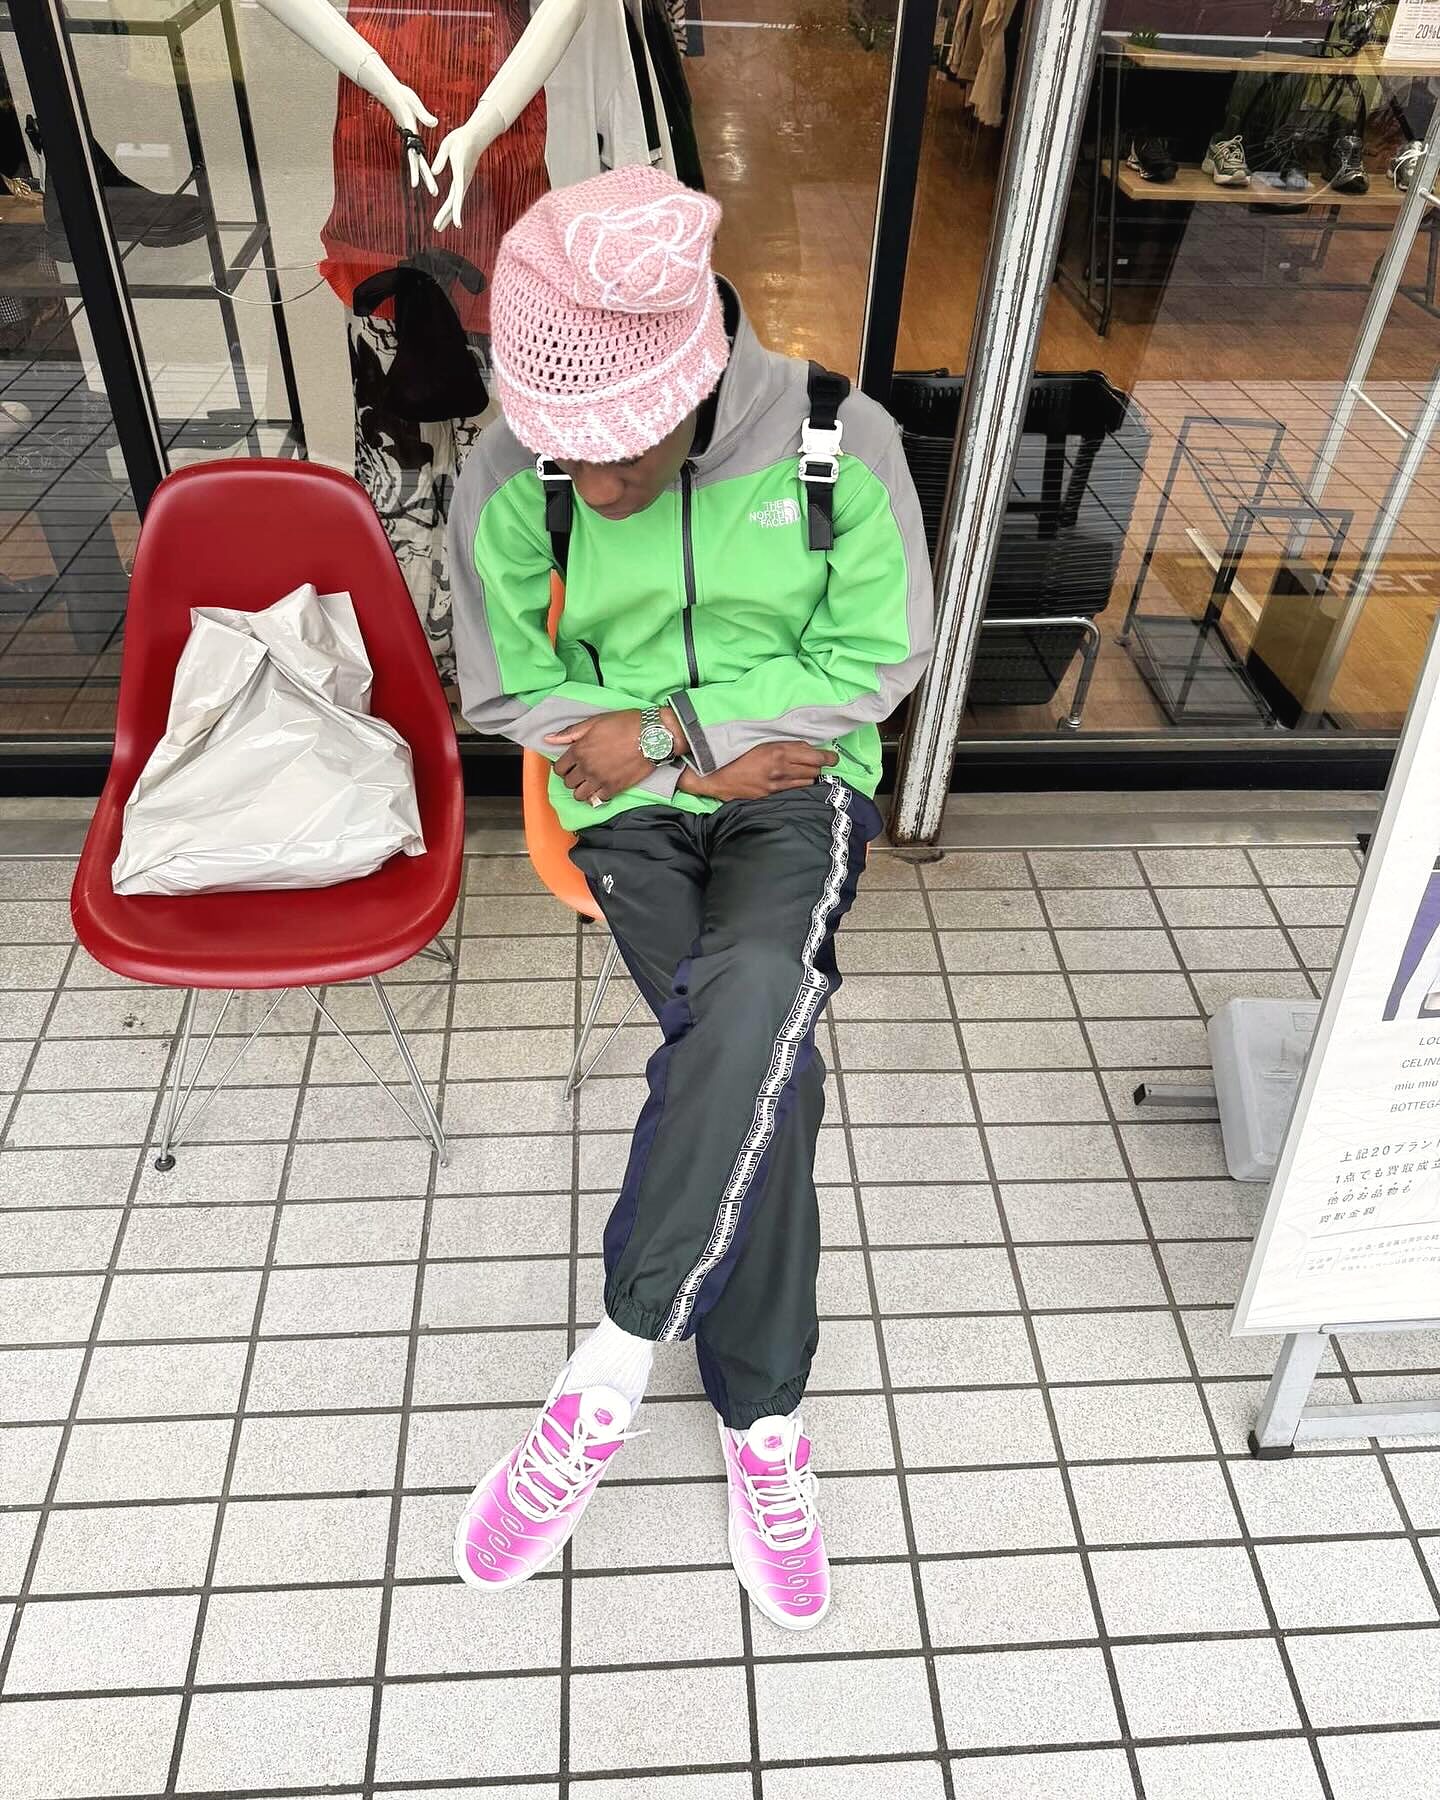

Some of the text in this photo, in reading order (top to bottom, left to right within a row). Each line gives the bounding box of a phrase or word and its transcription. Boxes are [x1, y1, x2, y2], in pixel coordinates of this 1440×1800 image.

[762, 500, 784, 511] THE
[761, 518, 786, 529] FACE
[1394, 1078, 1438, 1092] miu miu
